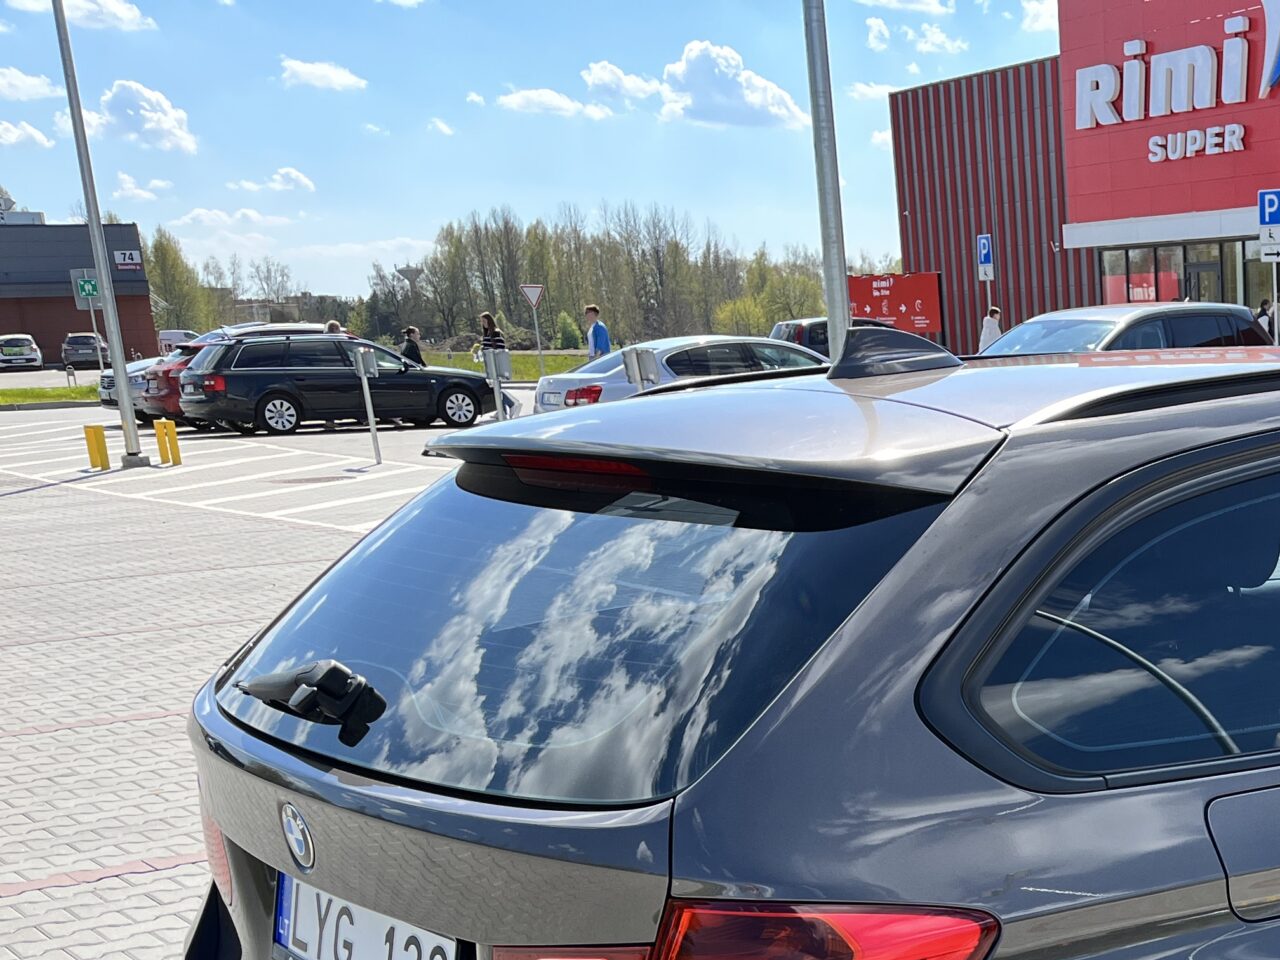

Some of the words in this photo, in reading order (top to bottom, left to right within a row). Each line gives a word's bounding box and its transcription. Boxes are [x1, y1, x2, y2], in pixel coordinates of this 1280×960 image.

[1076, 15, 1249, 130] Rimi
[1148, 123, 1245, 163] SUPER
[1264, 194, 1279, 222] P
[120, 252, 134, 262] 74
[981, 239, 988, 262] P
[278, 916, 289, 936] LT
